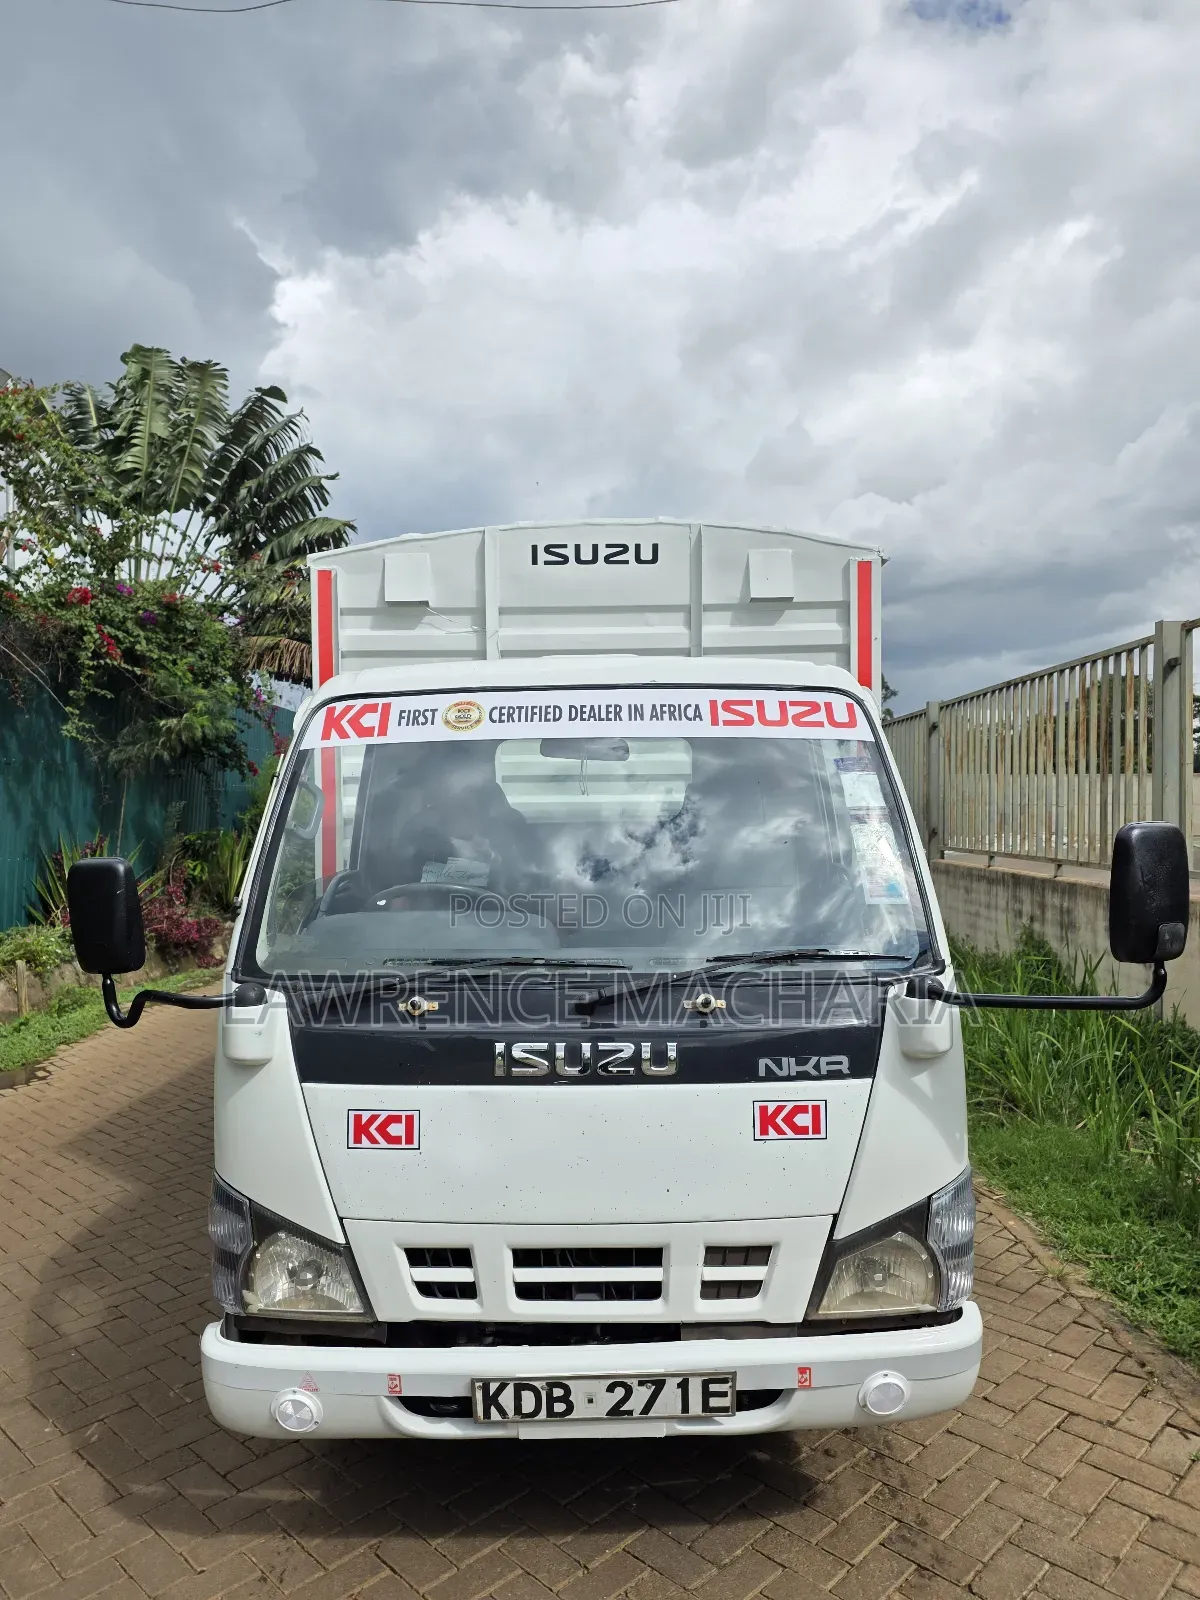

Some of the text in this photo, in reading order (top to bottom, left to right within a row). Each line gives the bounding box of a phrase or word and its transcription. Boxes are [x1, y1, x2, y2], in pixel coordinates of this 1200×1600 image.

[531, 543, 659, 565] ISUZU
[320, 702, 392, 741] KCI
[397, 708, 438, 727] FIRST
[488, 704, 563, 723] CERTIFIED
[568, 704, 624, 722] DEALER
[627, 704, 645, 721] IN
[649, 703, 704, 722] AFRICA
[708, 699, 858, 729] ISUZU
[494, 1042, 678, 1077] ISUZU
[758, 1055, 851, 1077] NKR
[353, 1113, 416, 1145] KCI
[758, 1104, 822, 1136] KCI
[482, 1377, 732, 1420] KDB 271E
